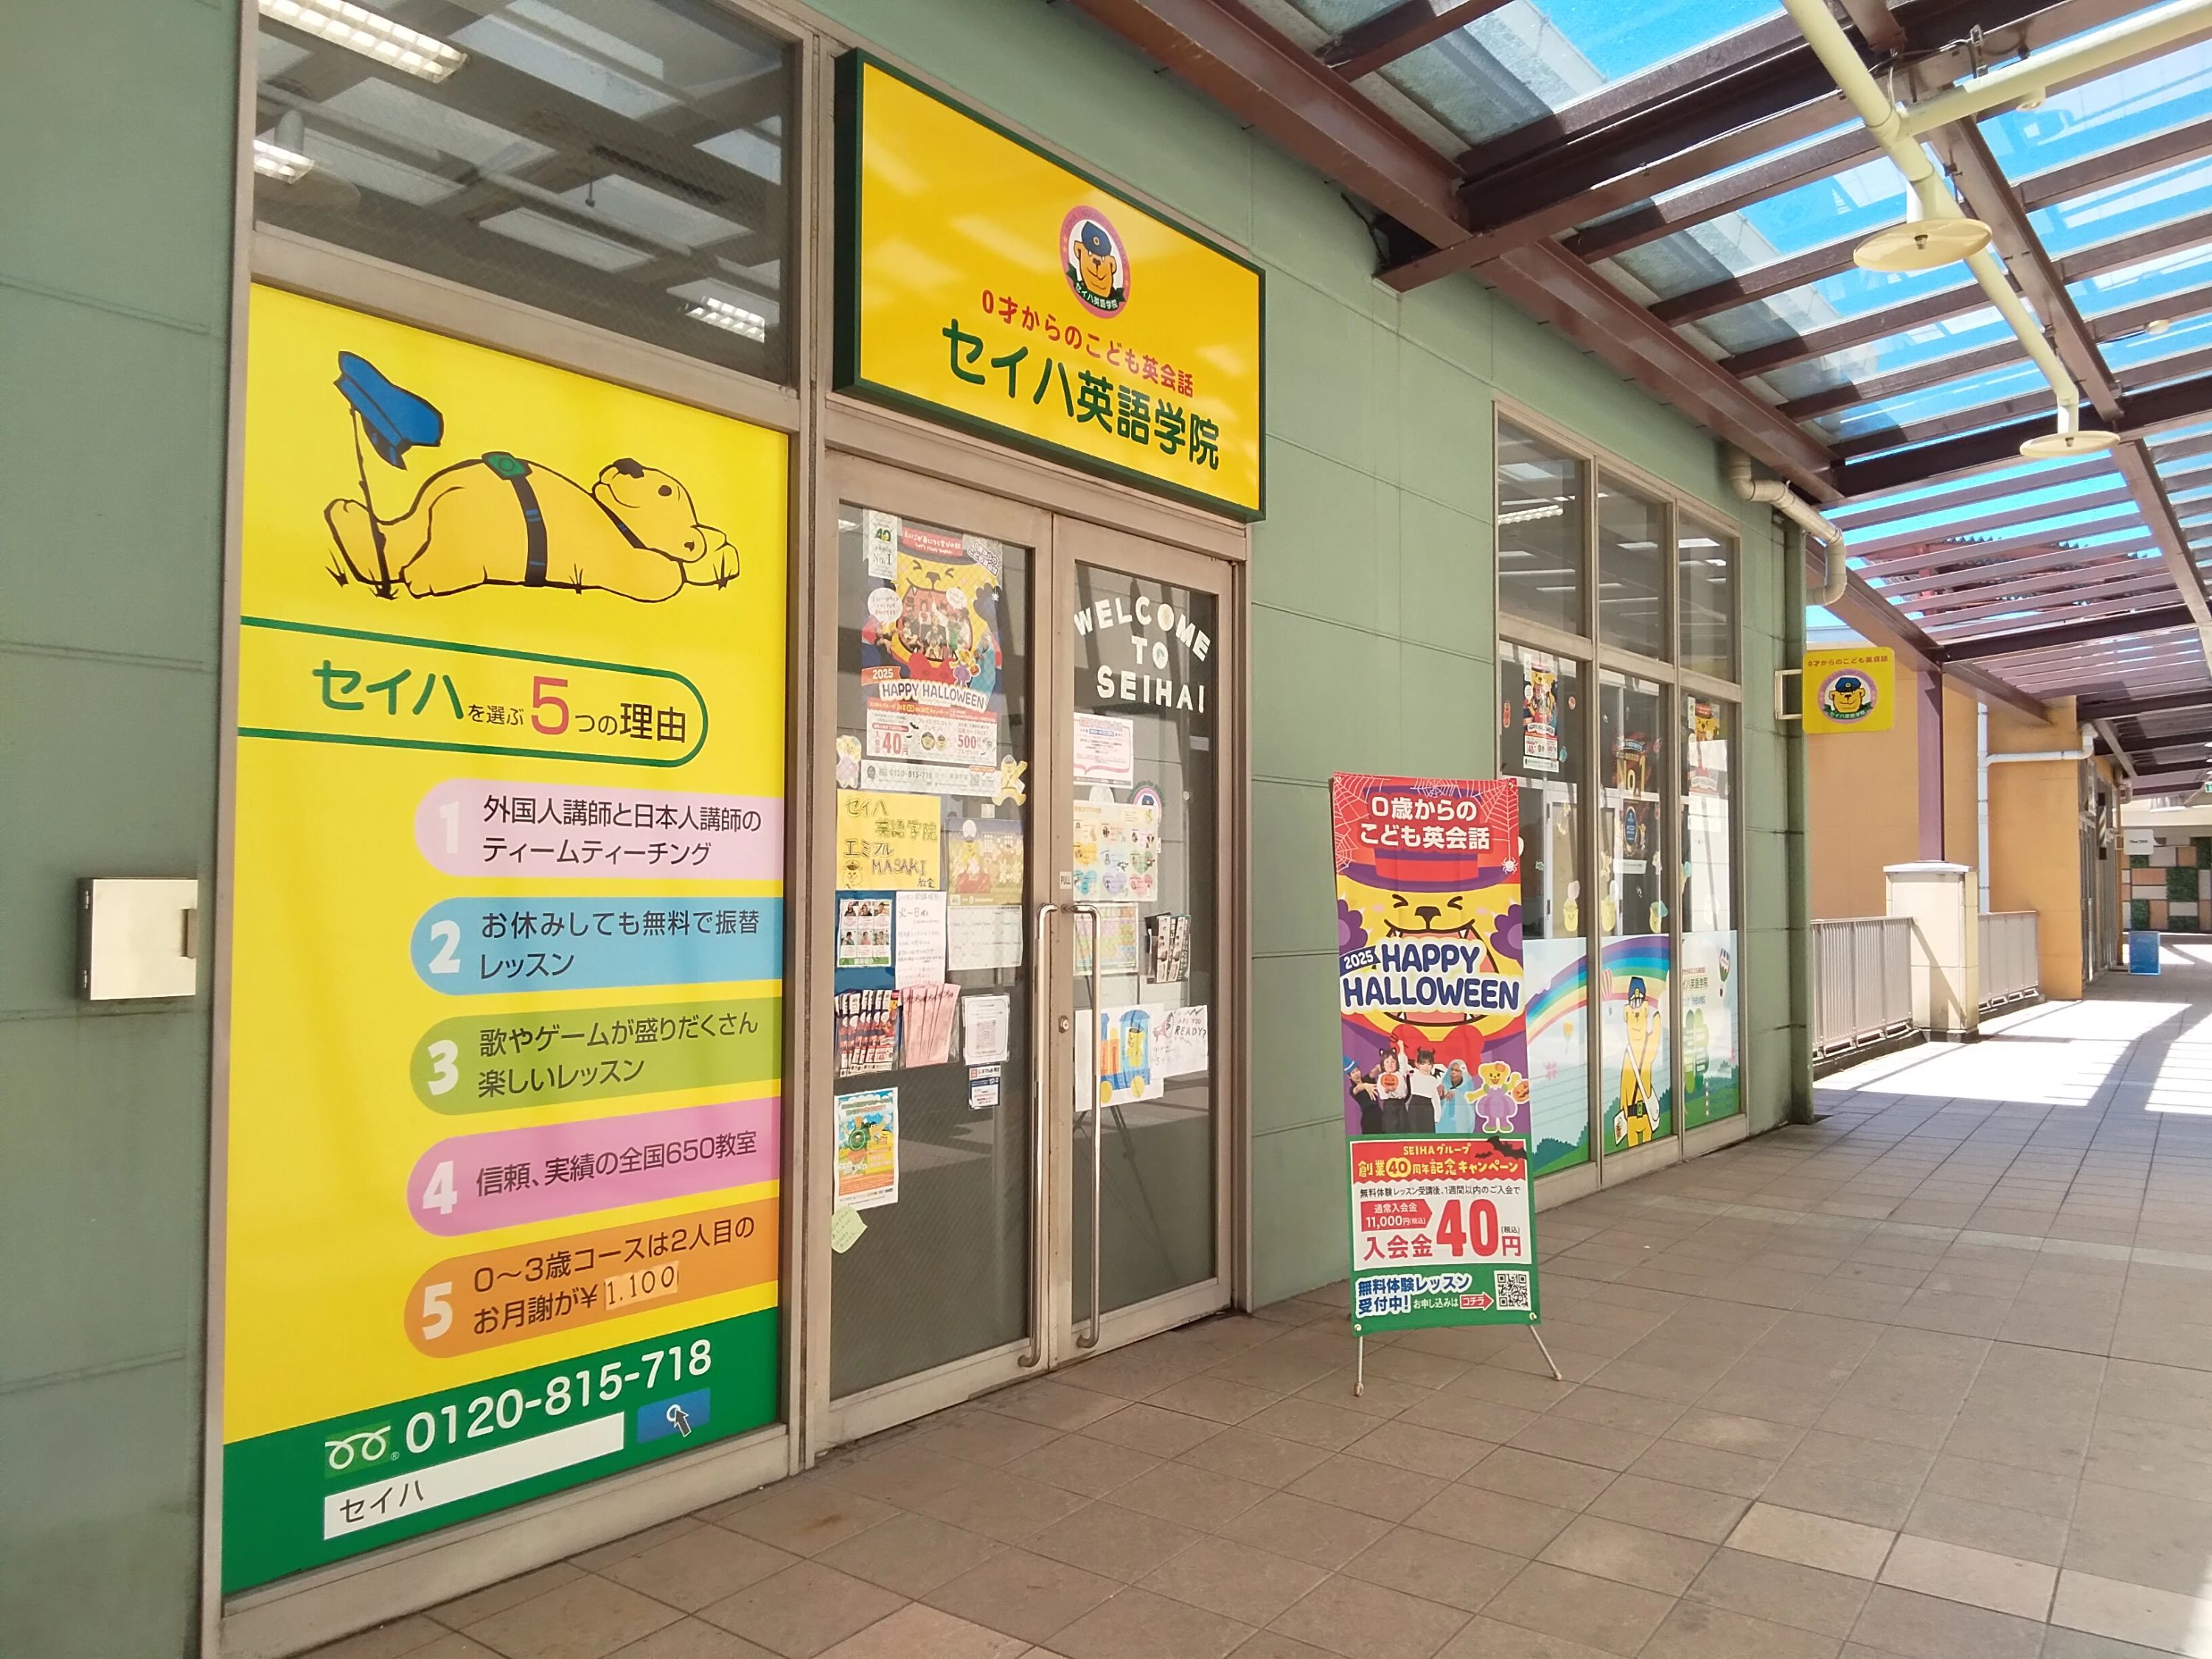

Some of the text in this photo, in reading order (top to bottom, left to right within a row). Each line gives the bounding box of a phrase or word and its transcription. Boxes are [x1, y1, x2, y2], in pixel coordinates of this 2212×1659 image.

[982, 289, 1194, 398] 0才からのこども英会話
[942, 318, 1220, 470] セイハ英語学院
[1074, 596, 1211, 662] WELCOME
[1131, 635, 1169, 669] TO
[872, 668, 894, 679] 2025
[882, 681, 985, 710] HAPPY HALLOWEEN
[882, 731, 902, 755] 40
[957, 734, 977, 749] 500
[483, 794, 762, 833] 外国人講師と日本人講師の
[844, 796, 890, 818] セイハ
[1371, 796, 1478, 821] 0歳からの
[438, 801, 460, 855] 1
[874, 818, 939, 841] 英語学院
[1360, 823, 1490, 850] こども英会話
[482, 836, 712, 866] ティームティーチング
[844, 838, 894, 858] エミフル
[871, 857, 927, 876] MASAKI
[1060, 875, 1071, 885] PULL
[481, 909, 760, 939] お休みしても無料で振替
[428, 919, 461, 974] 2
[1343, 943, 1481, 974] 2025 HAPPY
[481, 953, 575, 980] レッスン
[1342, 975, 1520, 1010] HALLOWEEN
[479, 1011, 759, 1057] 歌やゲームが盛りだくさん
[1175, 1025, 1207, 1039] READY?
[427, 1040, 459, 1096] 3
[478, 1059, 646, 1099] 楽しいレッスン
[476, 1130, 758, 1197] 信頼、実績の全国650教室
[1403, 1143, 1472, 1156] SEIHAグループ
[1357, 1157, 1519, 1178] 創業40周年記念キャンペーン
[422, 1160, 459, 1215] 4
[1360, 1185, 1521, 1198] 無料体験レッスン受講後、1週間以内のご入会で
[1374, 1203, 1418, 1214] 通常入会金
[1357, 1275, 1470, 1297] 無料体験レッスン
[422, 1281, 453, 1340] 5
[1357, 1295, 1485, 1315] 受付中! お申し込みは コチラ
[406, 1339, 712, 1454] 0120-815-718
[339, 1480, 424, 1523] セイハ
